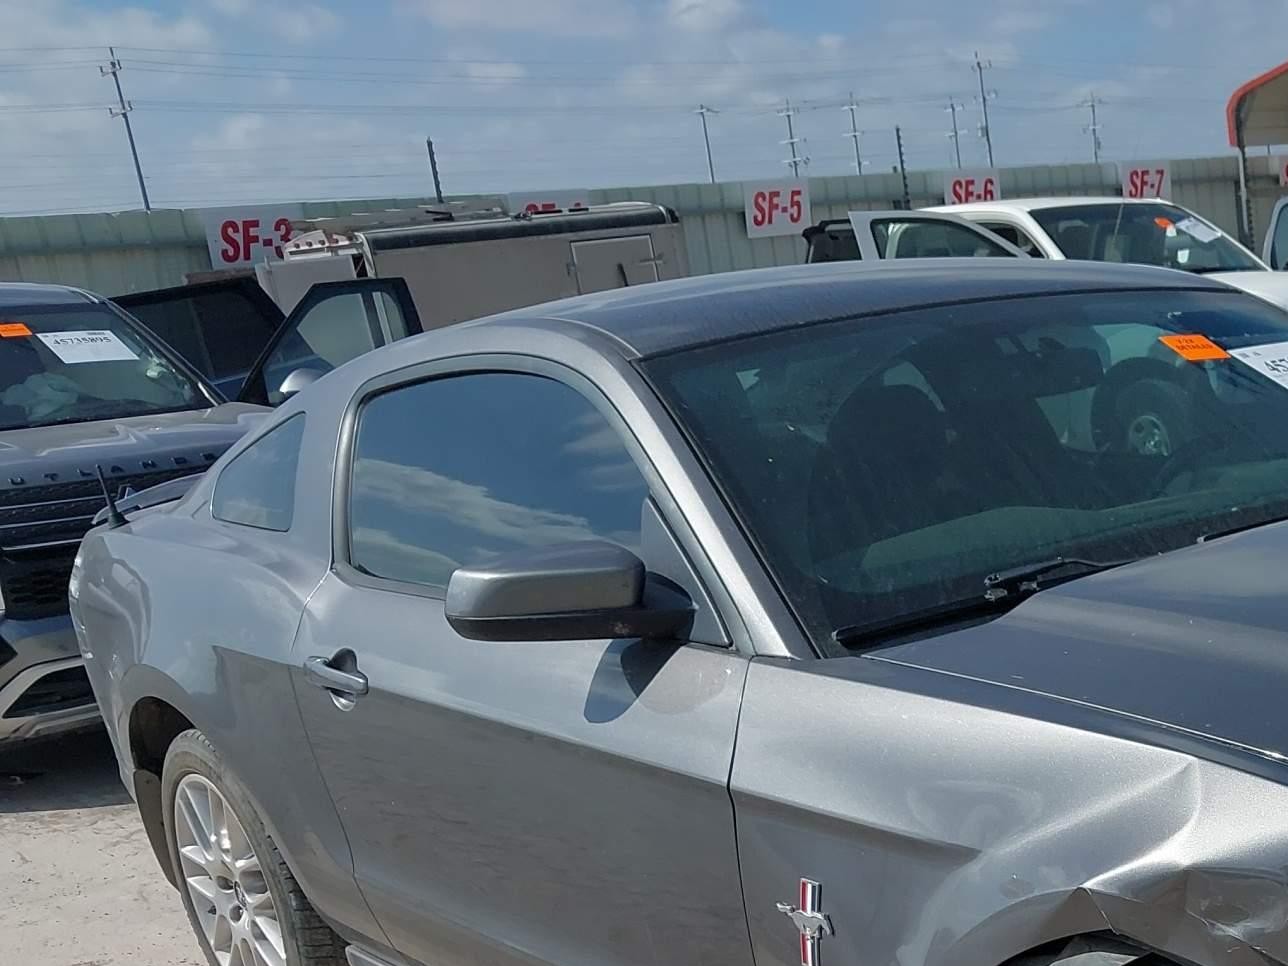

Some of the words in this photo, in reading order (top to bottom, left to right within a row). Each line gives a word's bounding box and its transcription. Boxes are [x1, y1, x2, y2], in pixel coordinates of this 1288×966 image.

[952, 178, 994, 204] SF-6
[1129, 169, 1165, 198] SF-7
[753, 190, 802, 226] SF-5
[220, 218, 292, 263] SF-3
